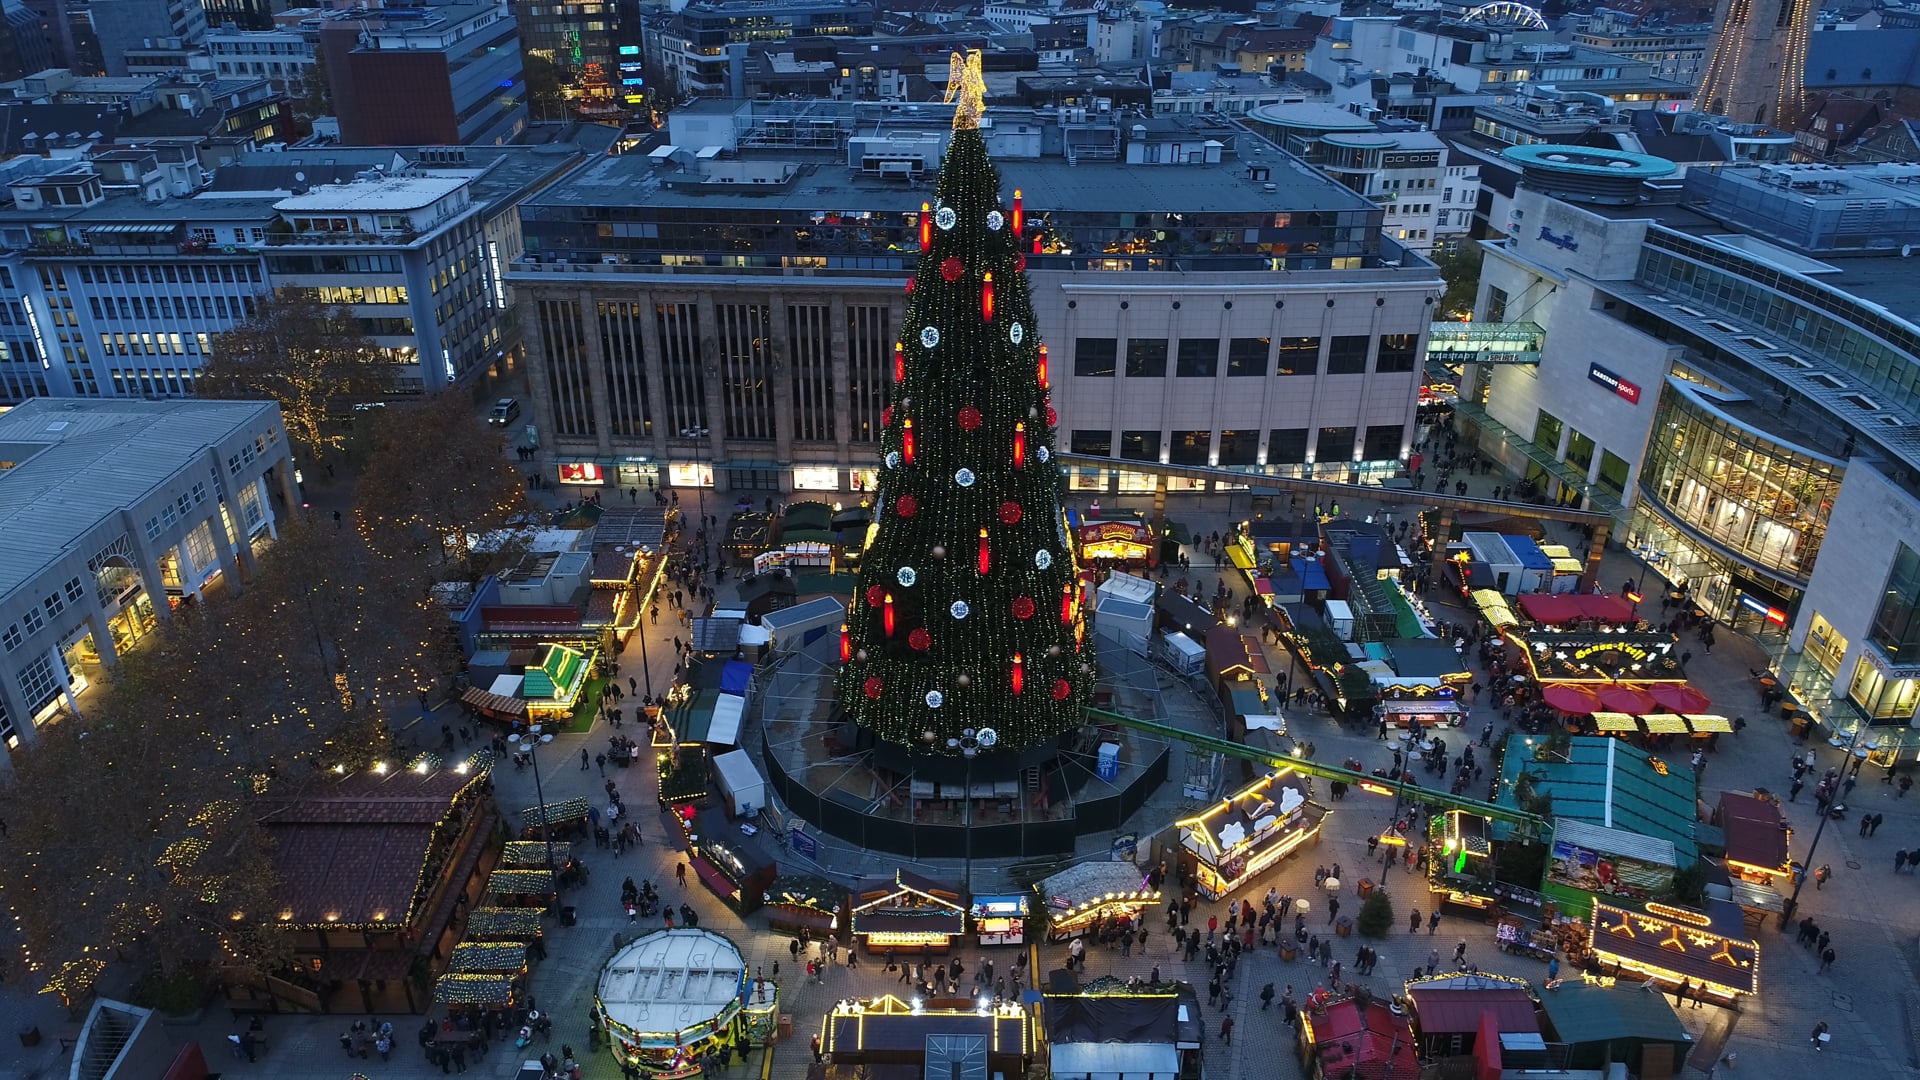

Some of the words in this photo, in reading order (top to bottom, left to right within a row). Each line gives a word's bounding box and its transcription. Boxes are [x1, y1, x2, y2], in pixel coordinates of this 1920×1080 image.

[1429, 352, 1476, 361] KARSTADT
[1592, 369, 1619, 387] KARSTADT
[1617, 383, 1635, 396] sports
